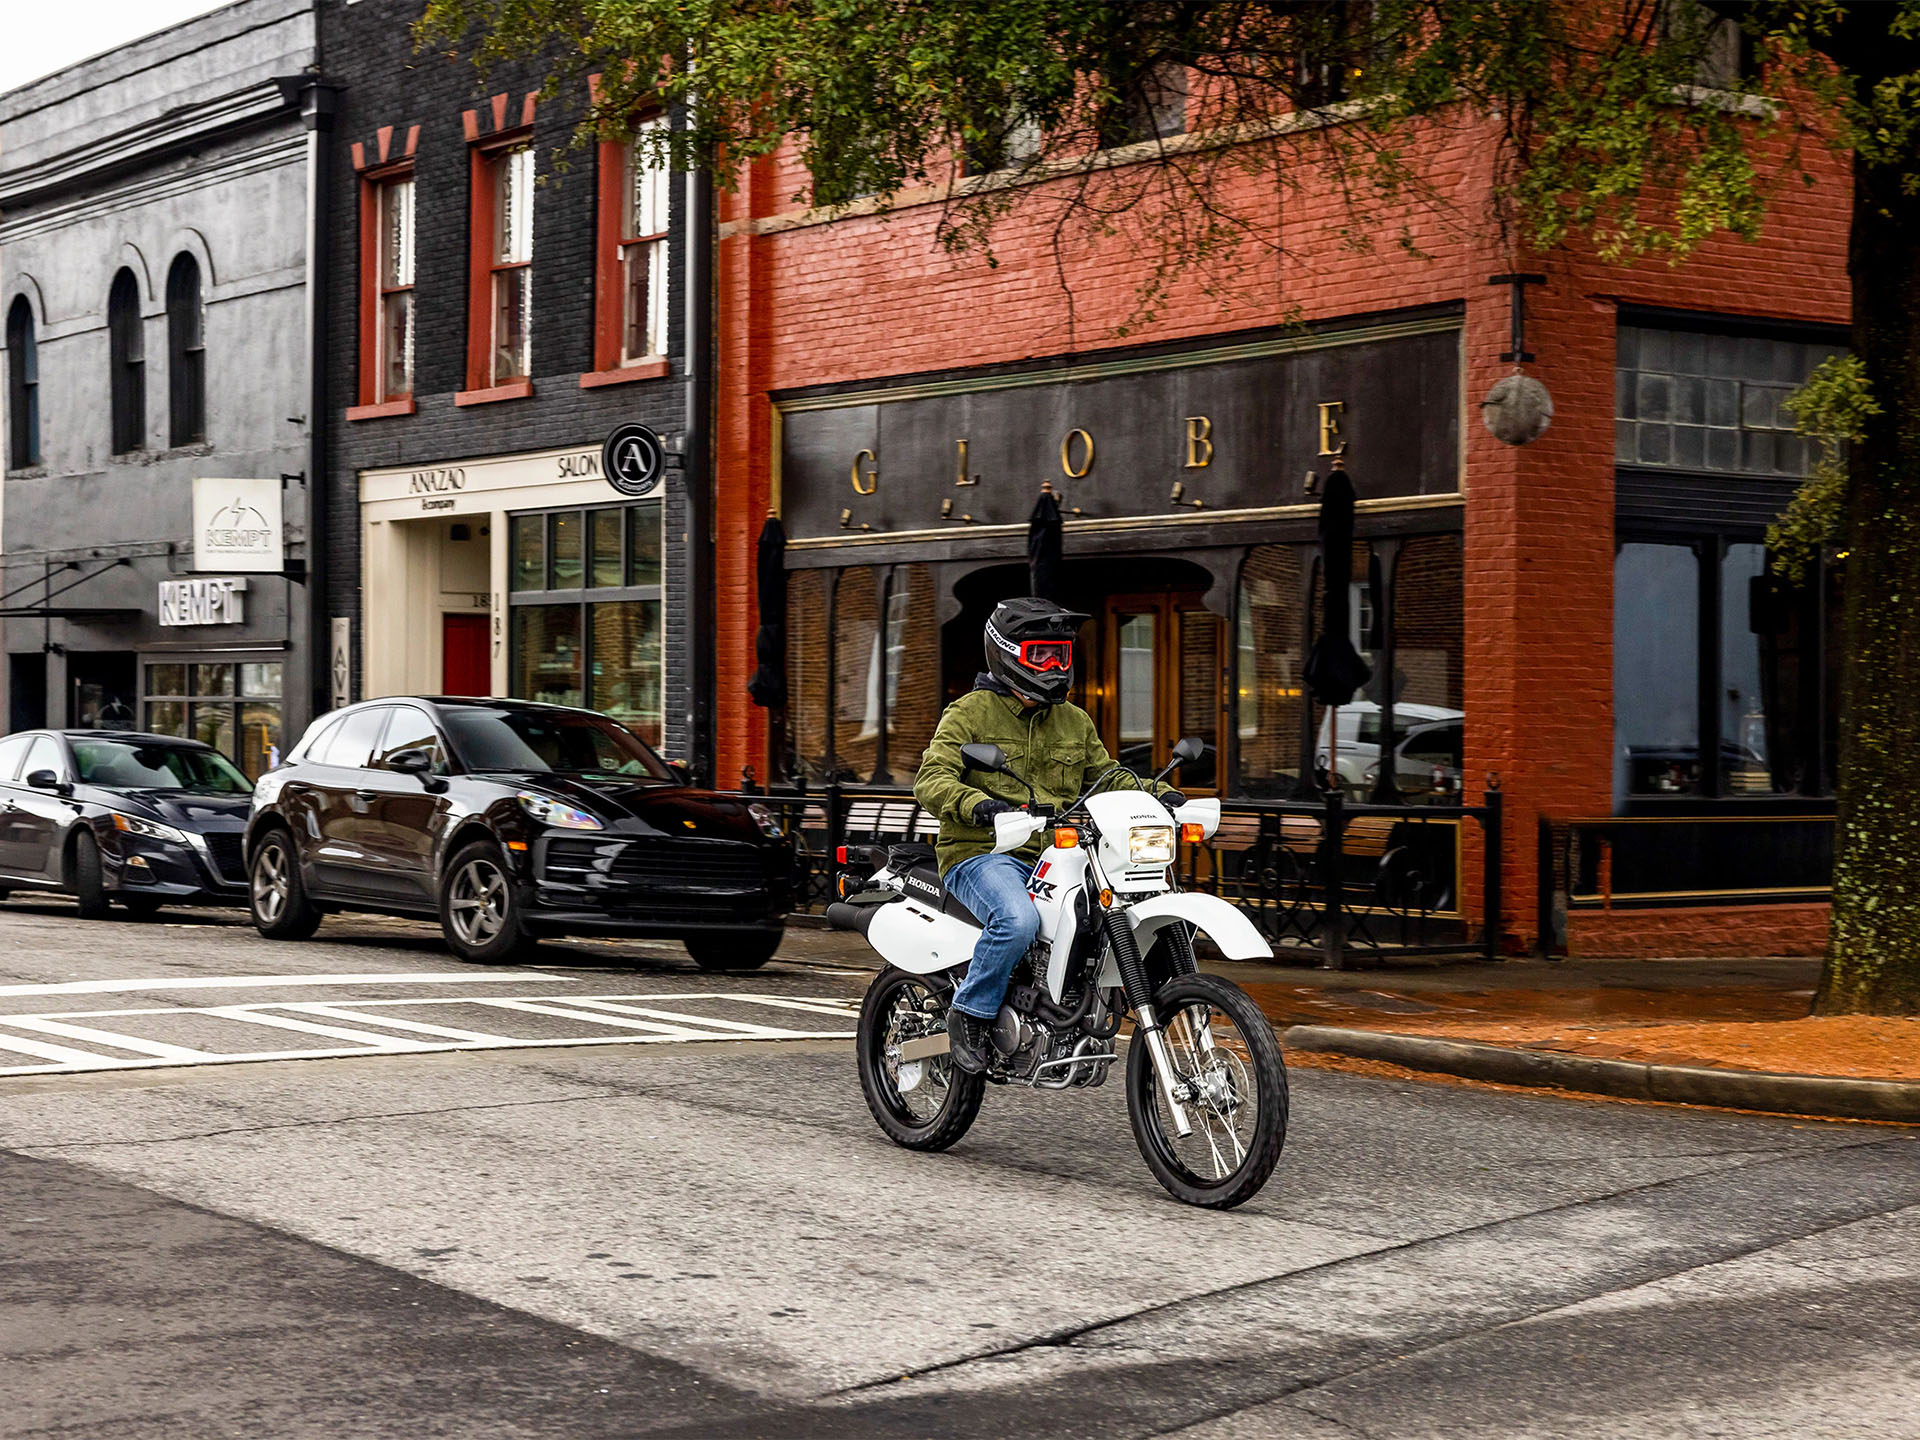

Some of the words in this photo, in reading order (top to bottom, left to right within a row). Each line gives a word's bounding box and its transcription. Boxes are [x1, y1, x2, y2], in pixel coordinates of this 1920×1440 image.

[621, 443, 648, 472] A
[851, 402, 1347, 495] GLOBE
[558, 455, 599, 478] SALON
[409, 469, 466, 494] ANAZAO
[205, 529, 271, 547] KEMPT
[158, 578, 245, 626] KEMPT
[989, 627, 1017, 652] RACING
[907, 876, 941, 897] HONDA
[1026, 877, 1057, 900] XR
